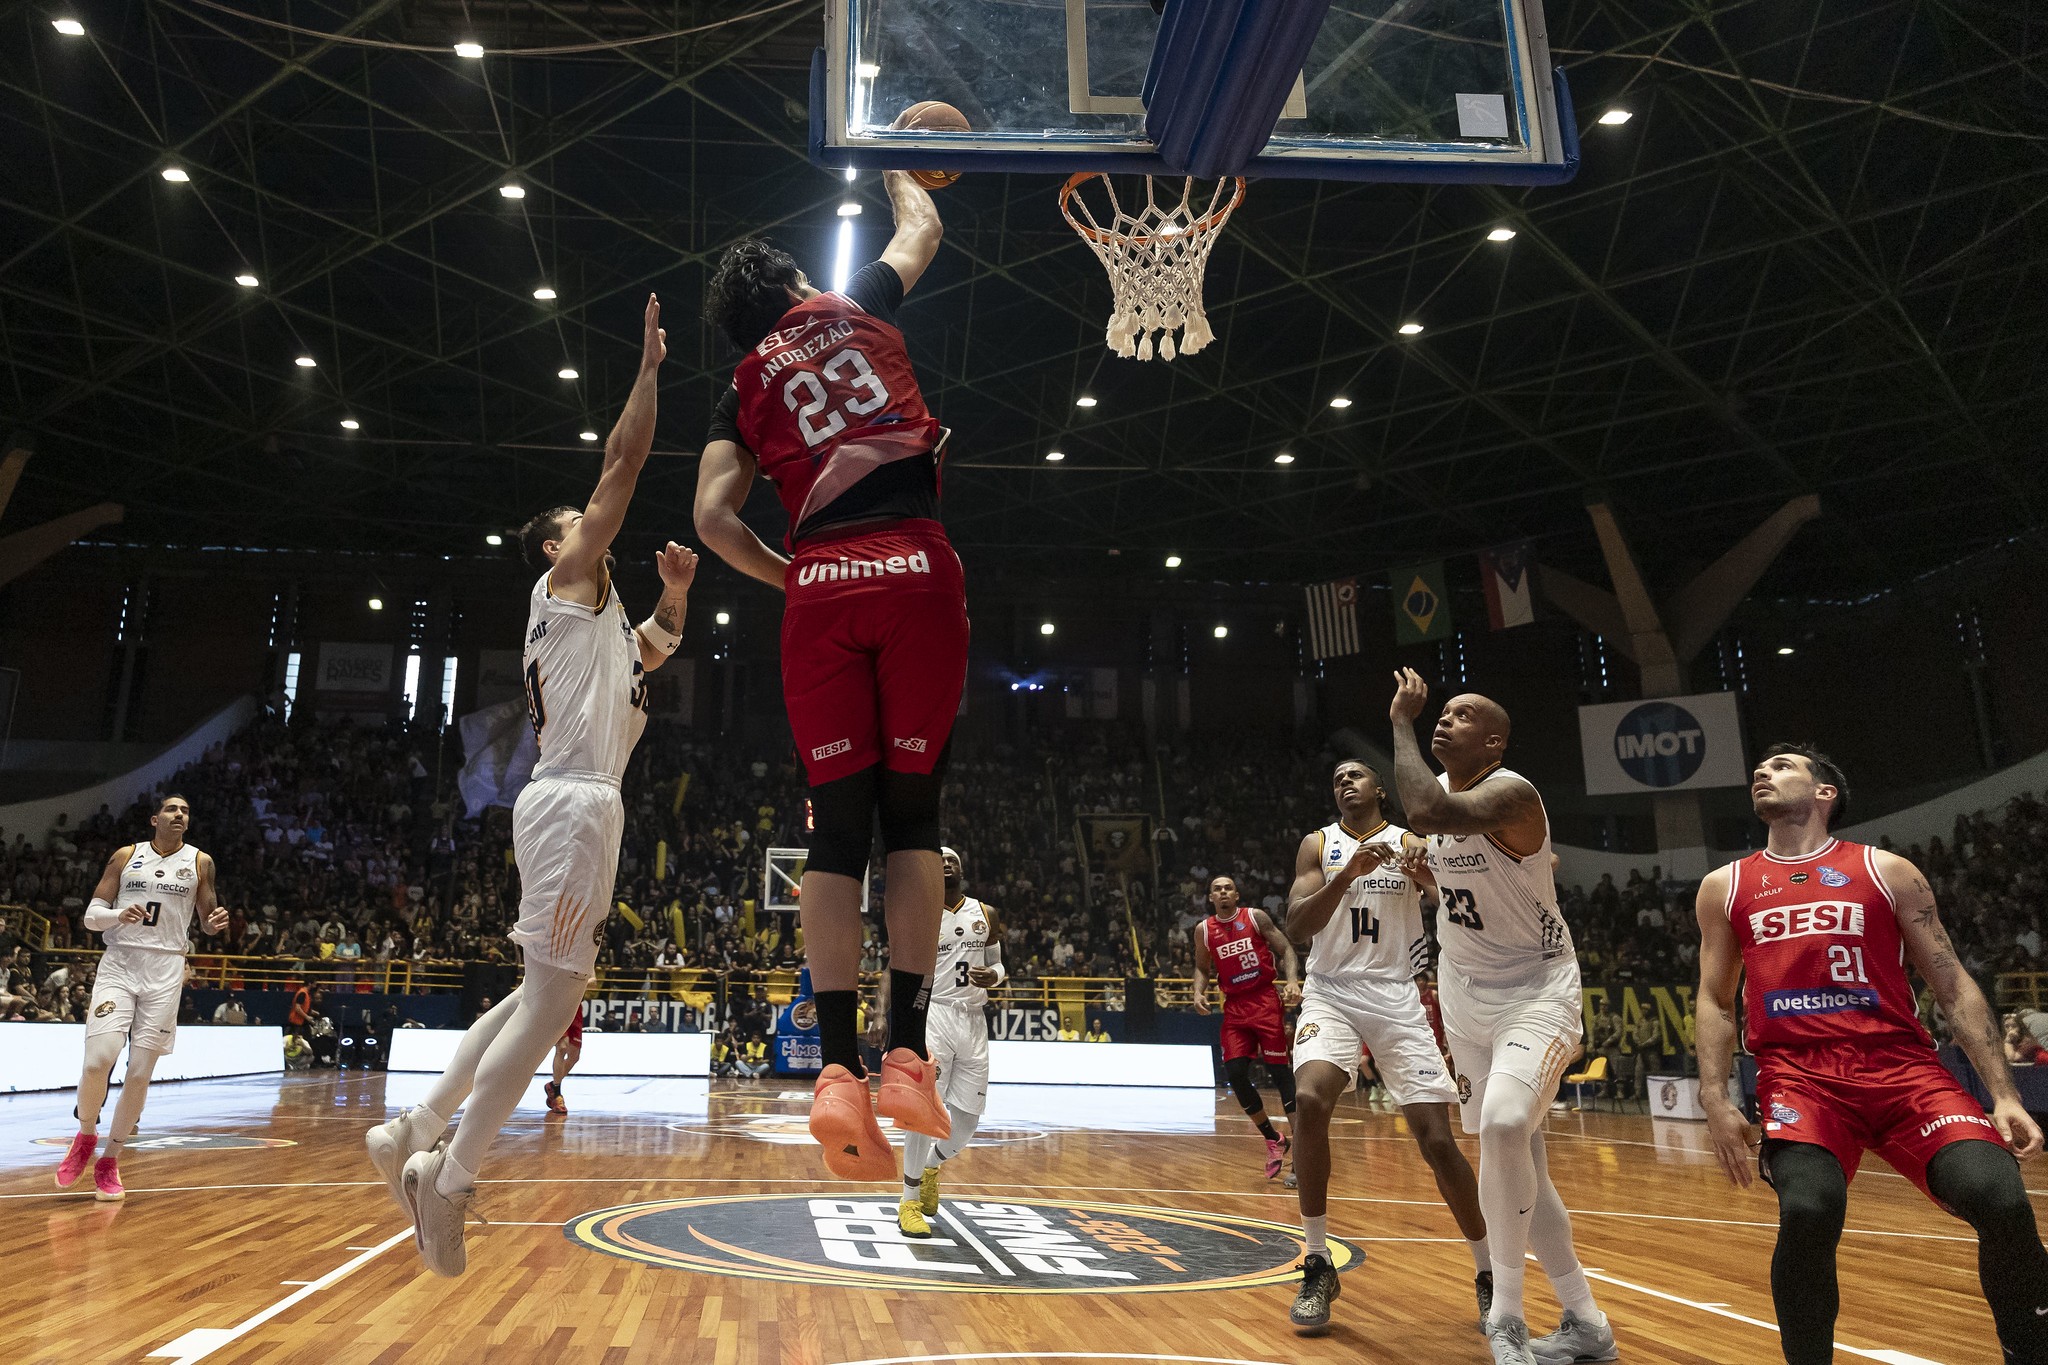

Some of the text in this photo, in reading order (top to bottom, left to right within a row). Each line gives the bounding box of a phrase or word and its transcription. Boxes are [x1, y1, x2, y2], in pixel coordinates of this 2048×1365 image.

[760, 320, 854, 389] ANDREZÃO
[784, 349, 889, 448] 23
[798, 551, 930, 586] Unimed
[814, 741, 848, 759] FIESP
[1618, 729, 1701, 760] IMOT
[1443, 853, 1487, 867] necton
[156, 882, 189, 894] necton
[1363, 877, 1406, 890] necton
[1754, 887, 1783, 899] LARULP
[1441, 886, 1484, 930] 23
[1762, 905, 1852, 938] SESI
[1350, 908, 1380, 943] 14
[1221, 940, 1249, 956] SESI
[1239, 951, 1260, 970] 29
[1828, 945, 1868, 983] 21
[956, 961, 969, 987] 3
[807, 1199, 983, 1274] FPB
[951, 1201, 1140, 1280] FINAIS
[1066, 1219, 1181, 1257] 2026
